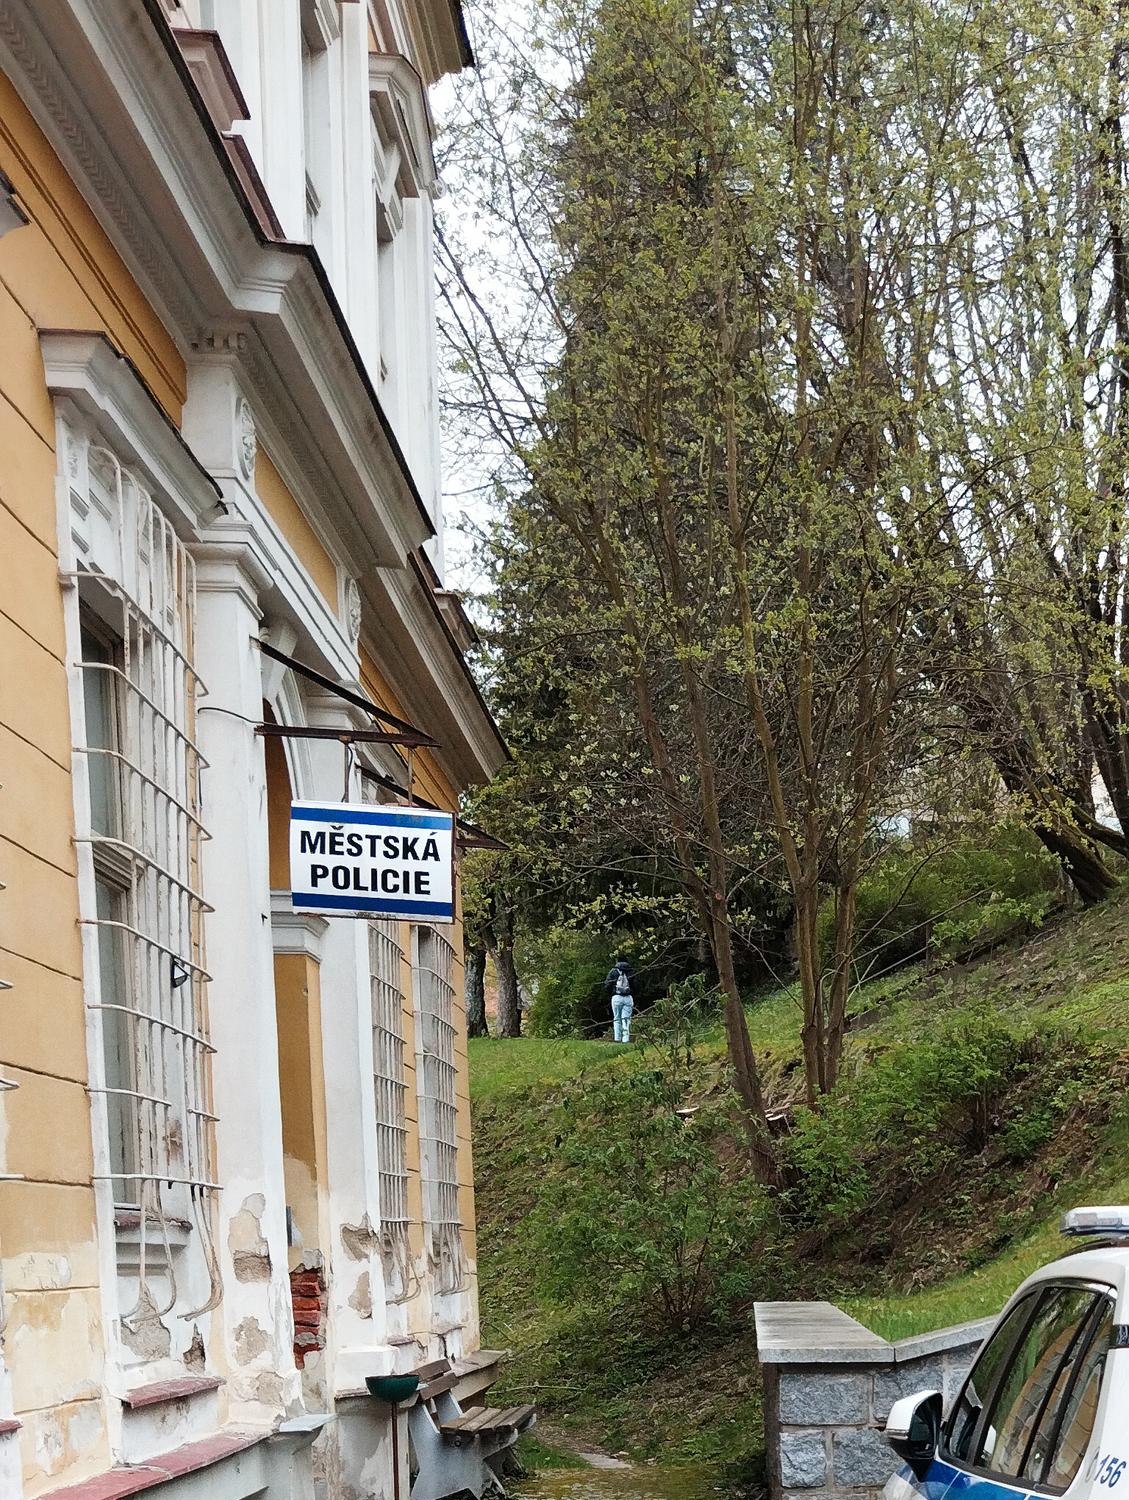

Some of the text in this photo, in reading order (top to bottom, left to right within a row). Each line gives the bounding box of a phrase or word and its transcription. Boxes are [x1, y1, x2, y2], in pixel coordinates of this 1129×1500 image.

[300, 825, 441, 862] MĚSTSKÁ
[310, 864, 431, 895] POLICIE
[1096, 1454, 1128, 1488] 156
